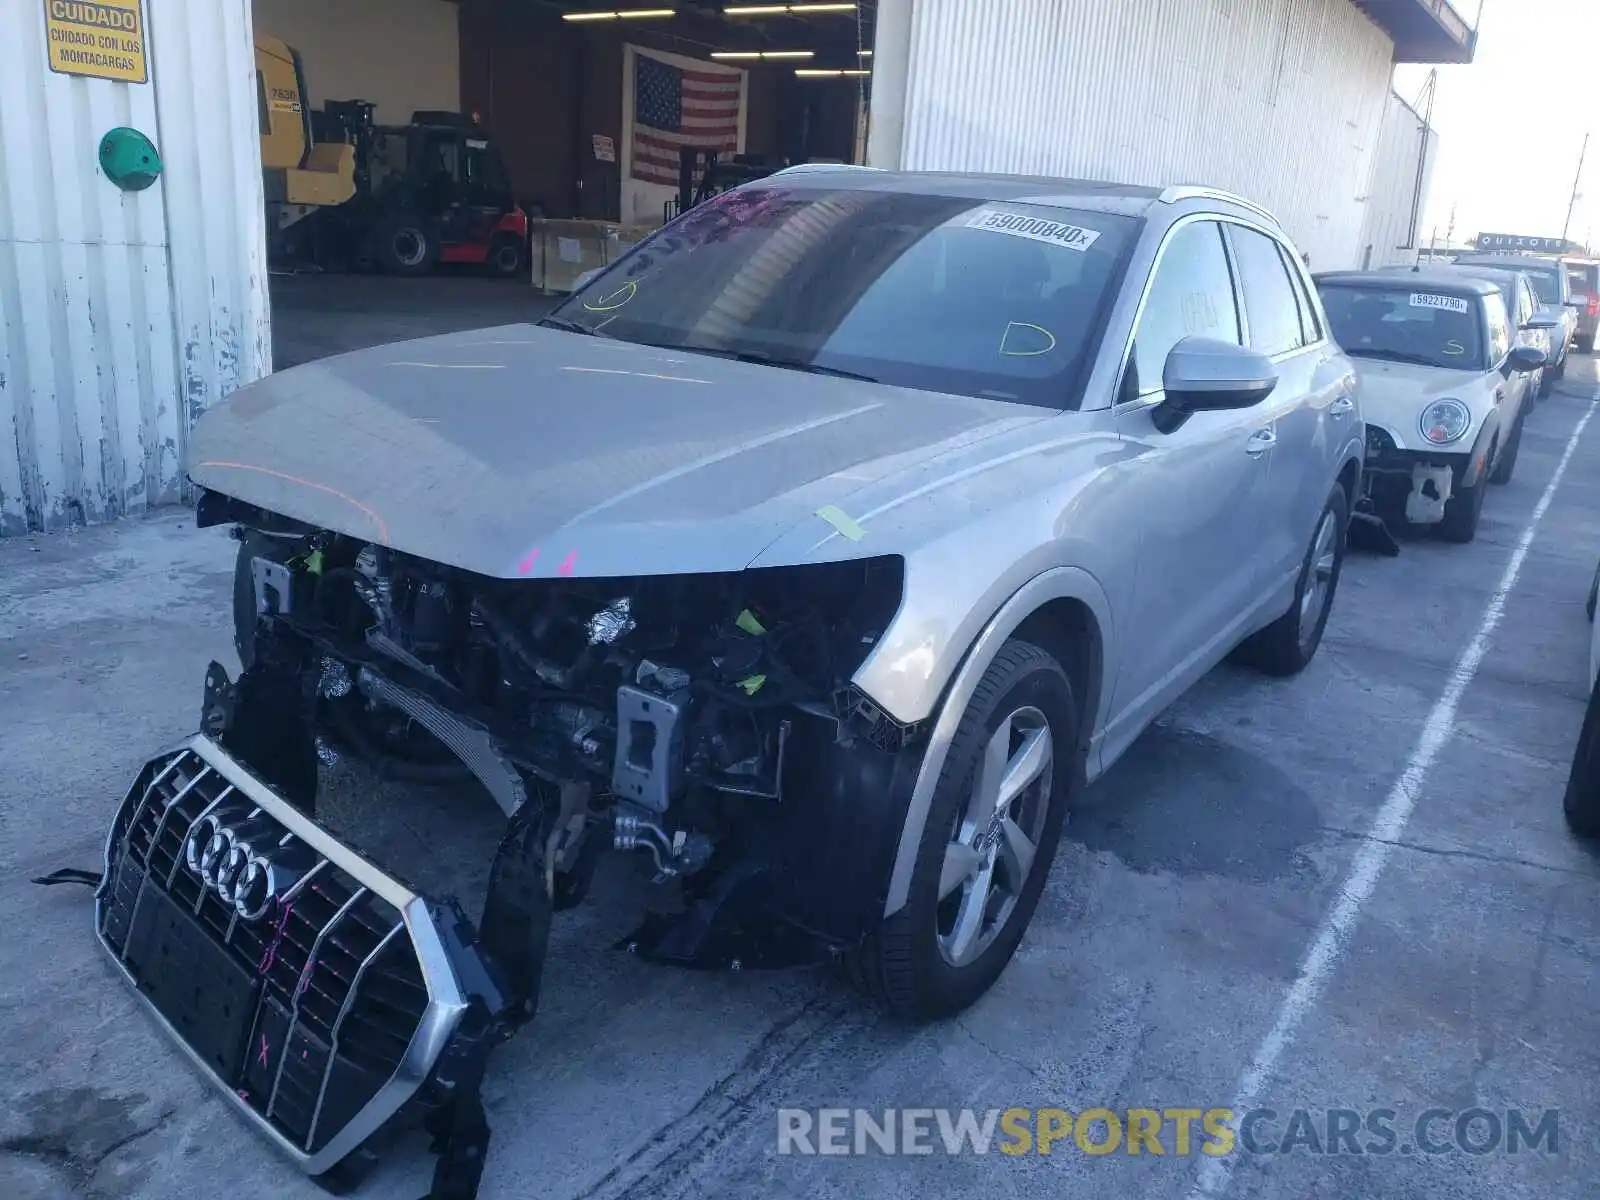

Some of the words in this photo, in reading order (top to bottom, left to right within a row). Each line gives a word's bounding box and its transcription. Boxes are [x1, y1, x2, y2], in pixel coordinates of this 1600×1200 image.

[51, 1, 136, 29] CUIDADO
[51, 28, 95, 46] CUIDADO
[98, 35, 119, 49] CON
[121, 39, 140, 53] LOS
[60, 48, 135, 71] MONTACARGAS
